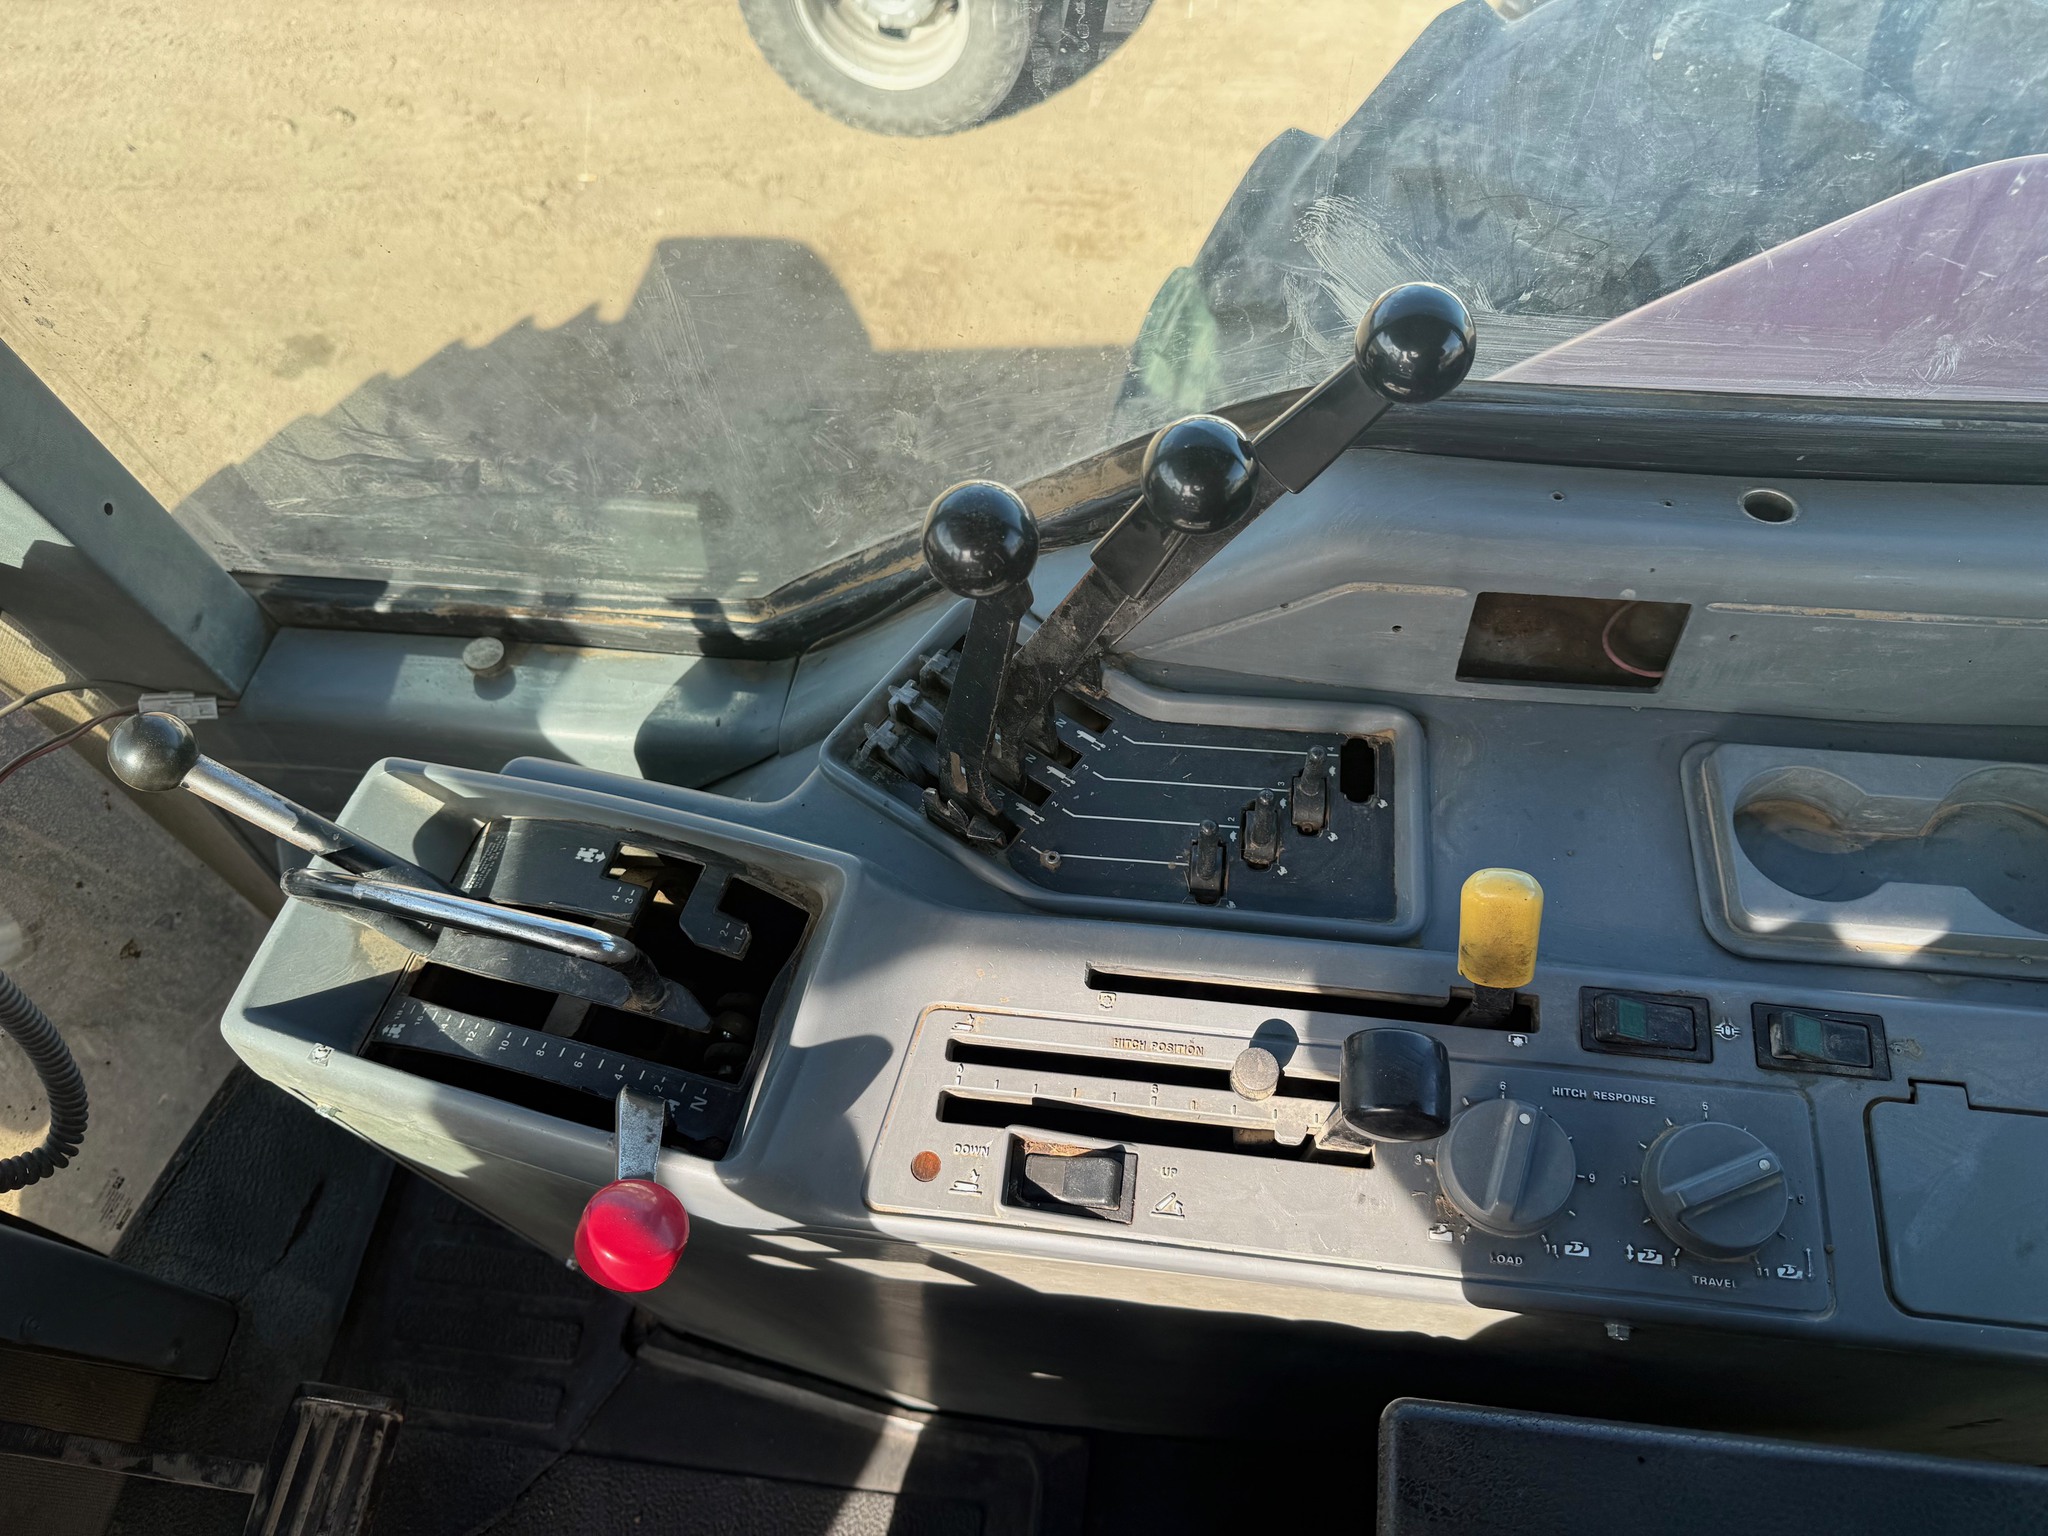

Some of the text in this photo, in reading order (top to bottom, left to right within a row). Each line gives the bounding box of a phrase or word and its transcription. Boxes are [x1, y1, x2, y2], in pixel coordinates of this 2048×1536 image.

[465, 1031, 478, 1043] 12
[498, 1040, 510, 1051] 10
[1113, 1038, 1205, 1056] HITCH POSITION
[574, 1060, 583, 1068] 6
[614, 1073, 624, 1081] 4
[653, 1084, 664, 1093] 2
[1500, 1080, 1507, 1091] 6
[1552, 1086, 1656, 1105] HITCH RESPONSE
[690, 1095, 708, 1112] N
[954, 1142, 990, 1157] DOWN
[1161, 1166, 1178, 1178] UP
[1588, 1172, 1596, 1184] 9
[1692, 1275, 1737, 1288] TRAVEL
